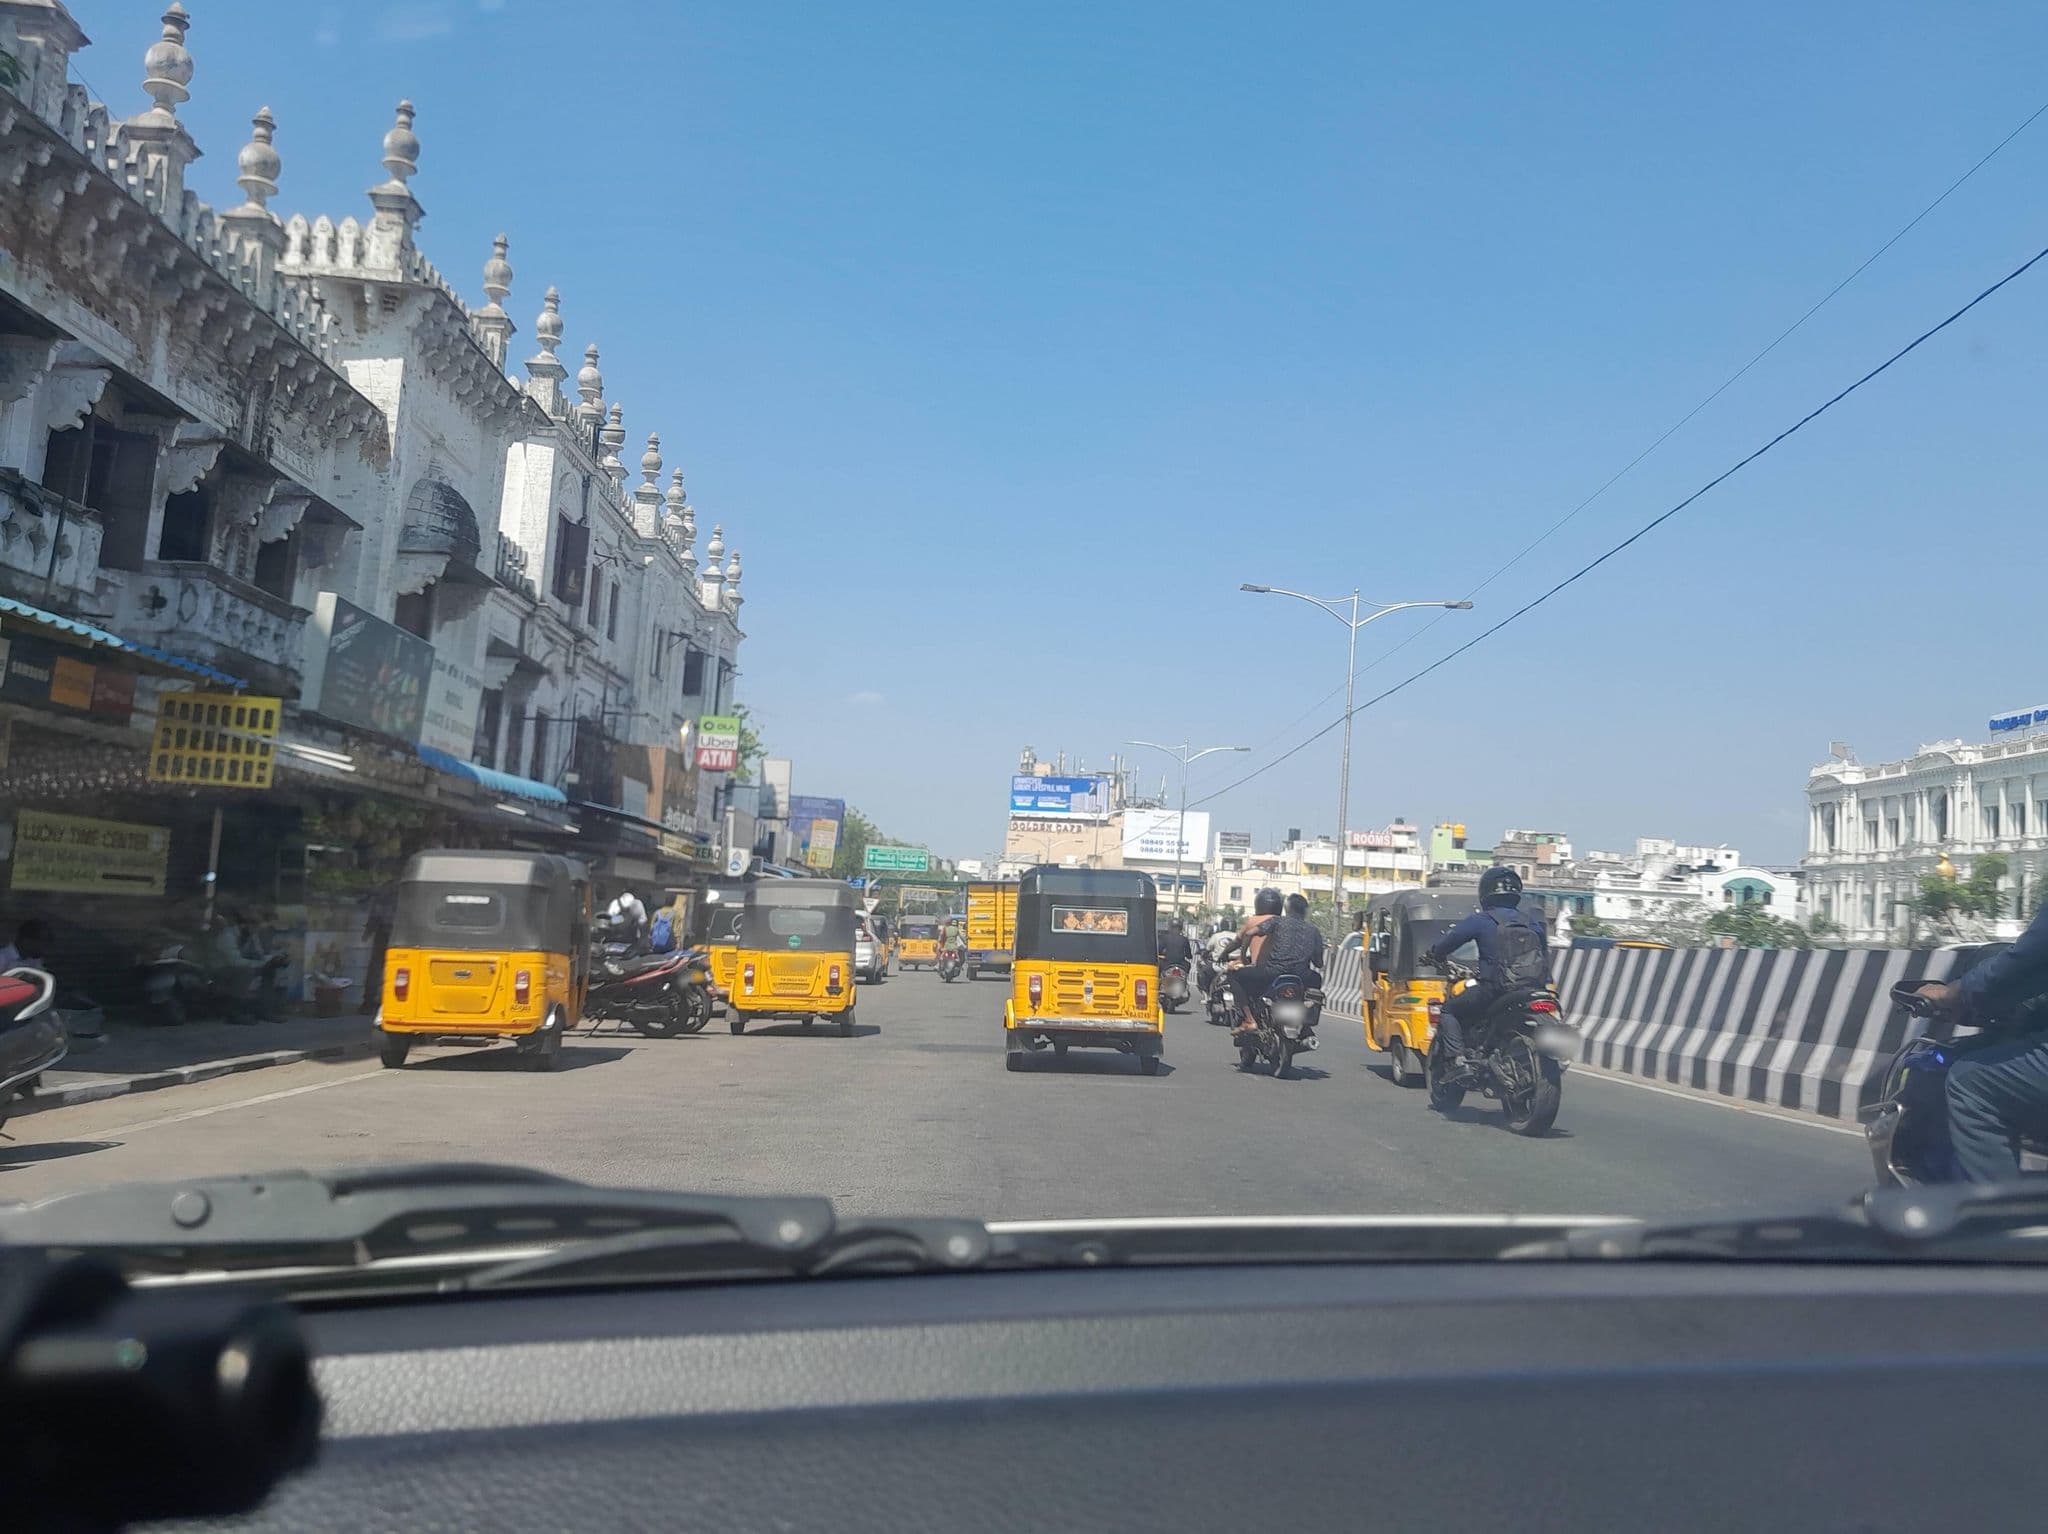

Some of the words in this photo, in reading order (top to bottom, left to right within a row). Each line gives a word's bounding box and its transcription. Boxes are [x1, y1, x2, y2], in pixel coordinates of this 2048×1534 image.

[701, 735, 736, 747] Uber
[700, 750, 733, 766] ATM
[1353, 832, 1391, 846] ROOMS
